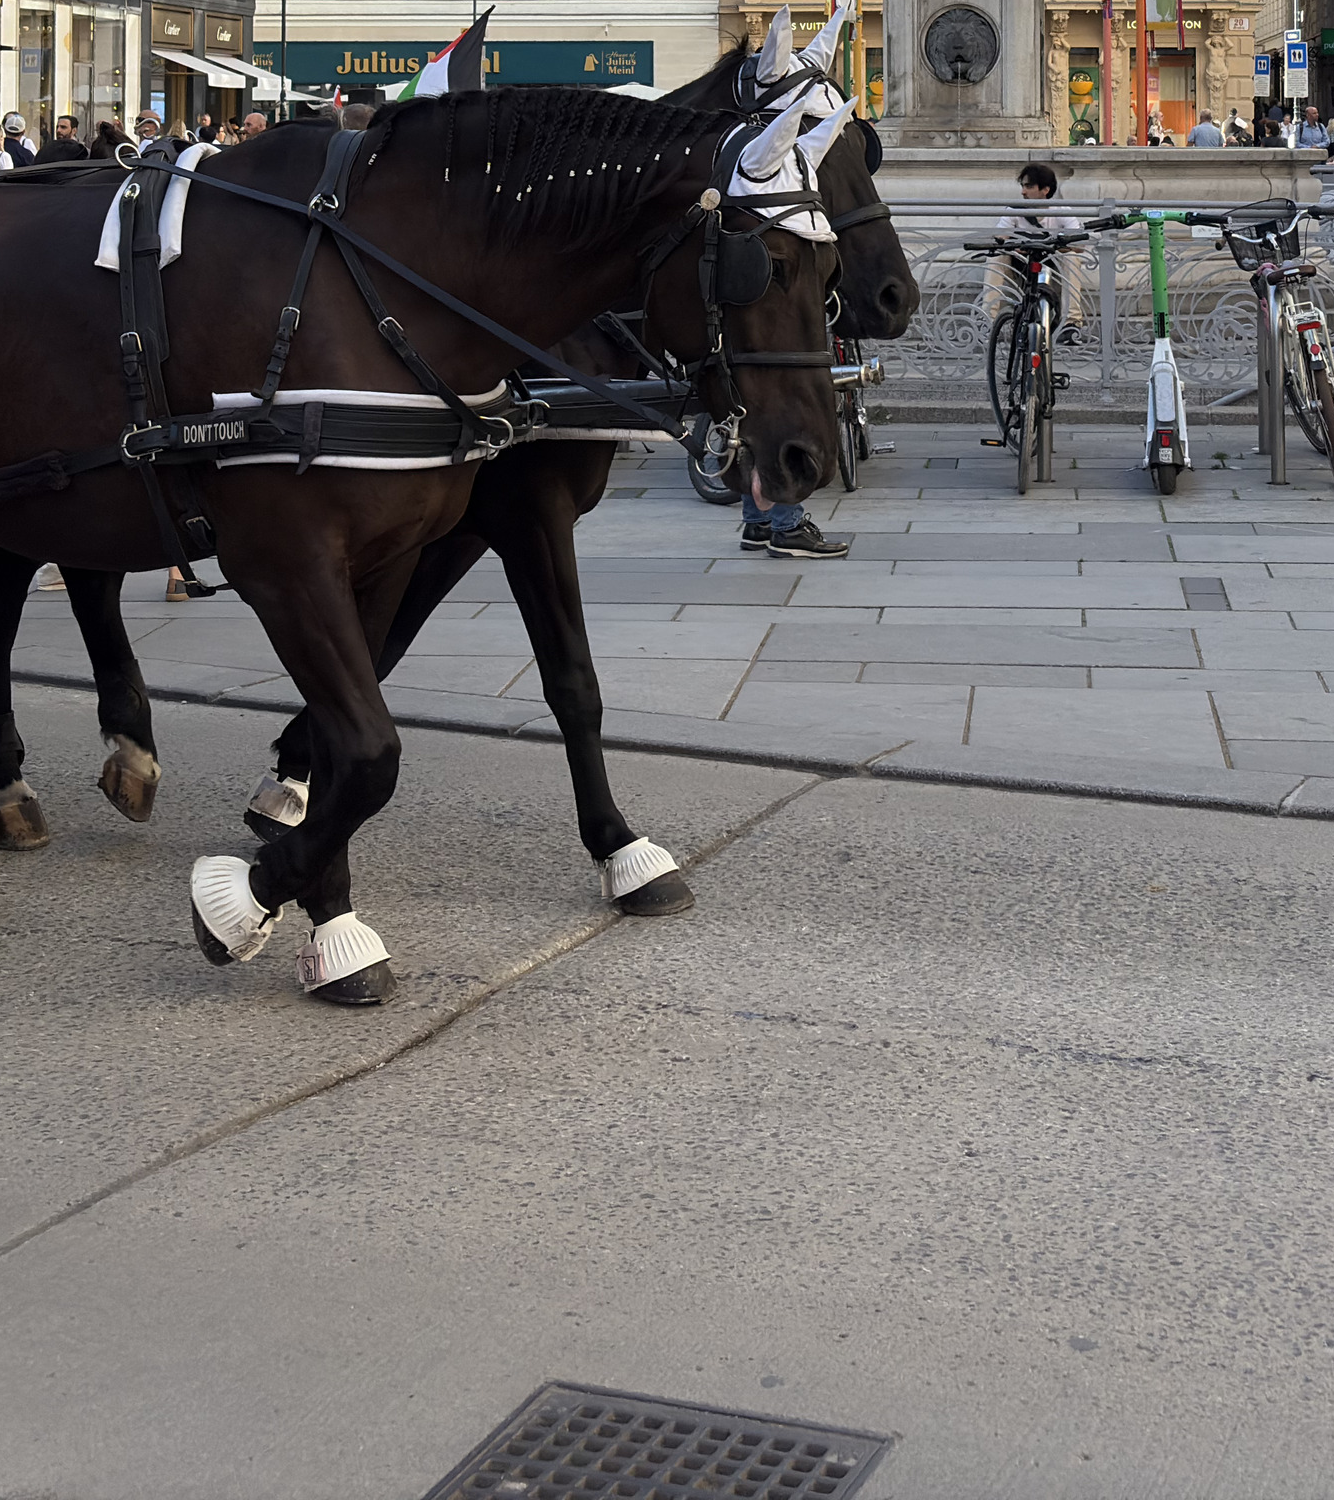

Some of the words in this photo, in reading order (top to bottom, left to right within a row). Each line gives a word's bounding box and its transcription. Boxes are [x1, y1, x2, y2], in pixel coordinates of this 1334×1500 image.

[164, 19, 181, 36] Cartier
[800, 22, 827, 31] VUITT
[1234, 18, 1244, 26] 20
[216, 25, 232, 42] Cartier
[336, 51, 420, 75] Julius
[606, 57, 637, 66] Julius
[609, 66, 635, 75] Meinl
[183, 424, 213, 444] DON'T
[213, 420, 245, 441] TOUCH
